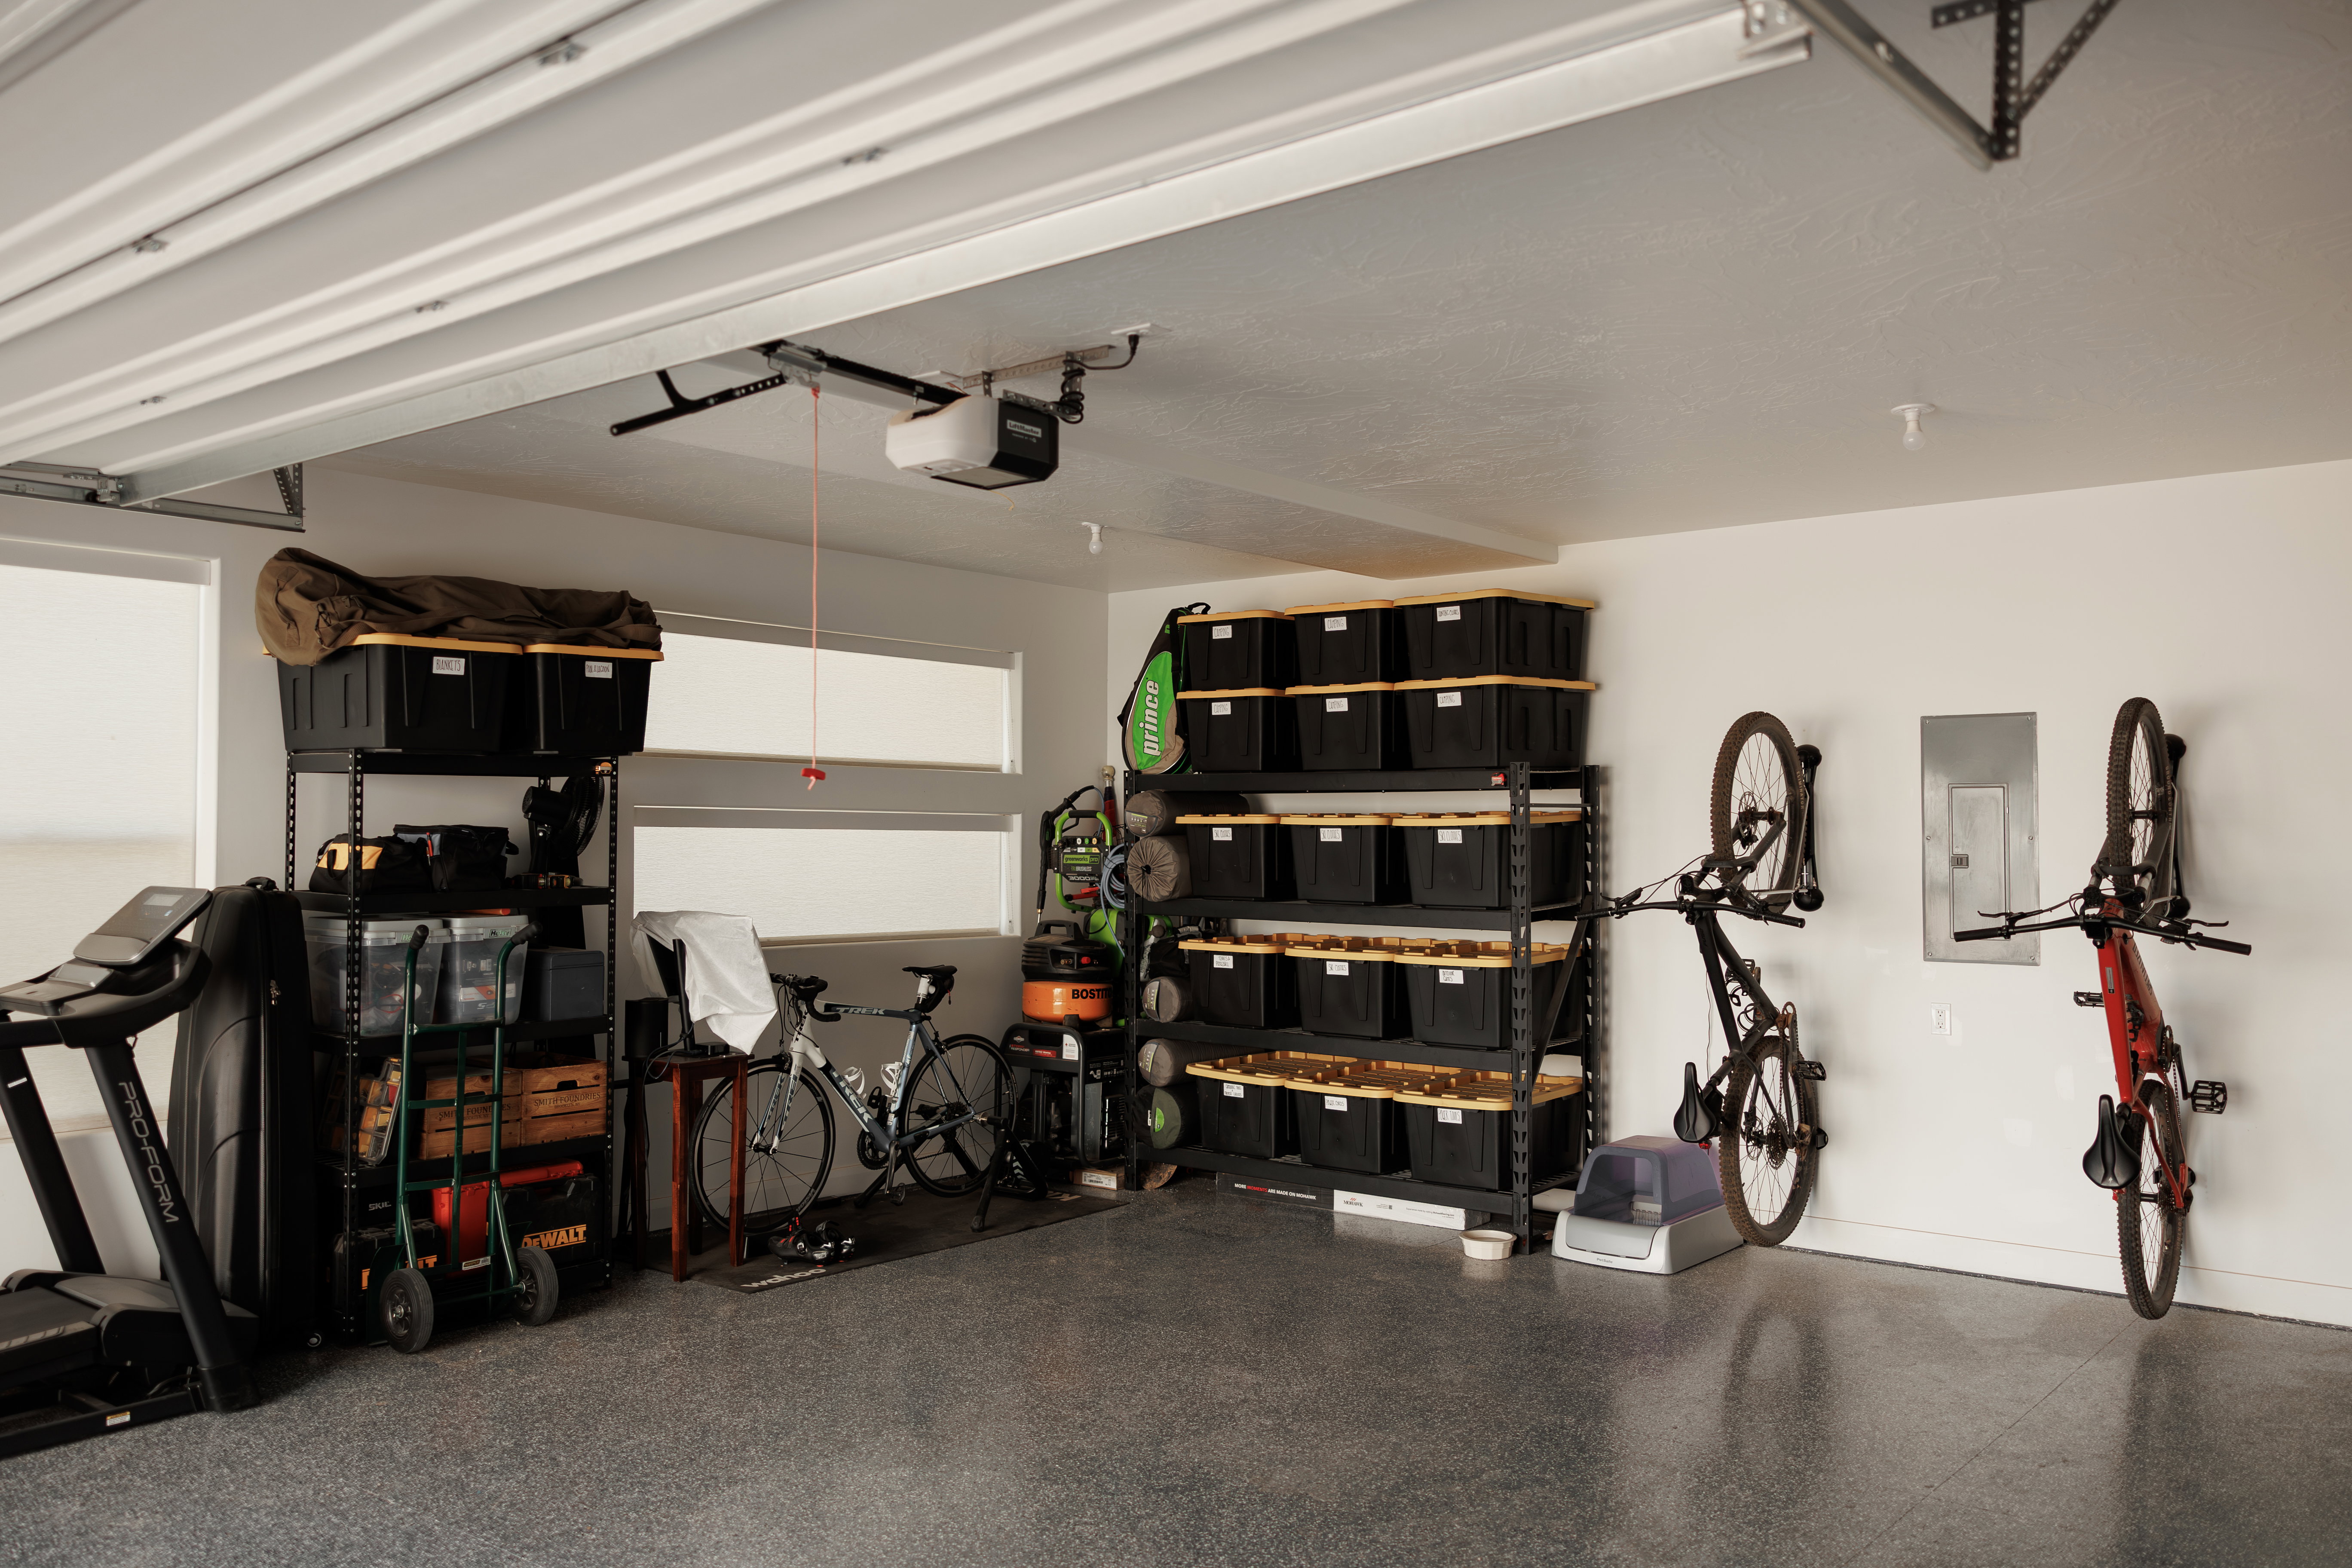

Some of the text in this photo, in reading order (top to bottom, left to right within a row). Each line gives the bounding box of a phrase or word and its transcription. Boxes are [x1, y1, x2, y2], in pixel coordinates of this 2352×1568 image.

[1328, 619, 1344, 629] CAMPING
[1214, 627, 1229, 637] CAMPING
[436, 659, 460, 671] BLANKETS
[1439, 695, 1455, 704] CAMPING
[1214, 704, 1228, 713] CAMPING
[1329, 700, 1343, 710] CAMPING
[1139, 680, 1162, 756] prince
[1327, 830, 1340, 839] CLOTHES
[1446, 830, 1461, 841] CLOTHES
[1072, 989, 1111, 999] BOSTIT
[534, 1092, 601, 1107] SMITH FOUNDRIES
[832, 1071, 874, 1123] TREK
[439, 1110, 457, 1119] SMIT
[1439, 1109, 1460, 1121] POWER TOOLS
[119, 1081, 179, 1222] PRO-FORM
[740, 1269, 827, 1287] wahoo
